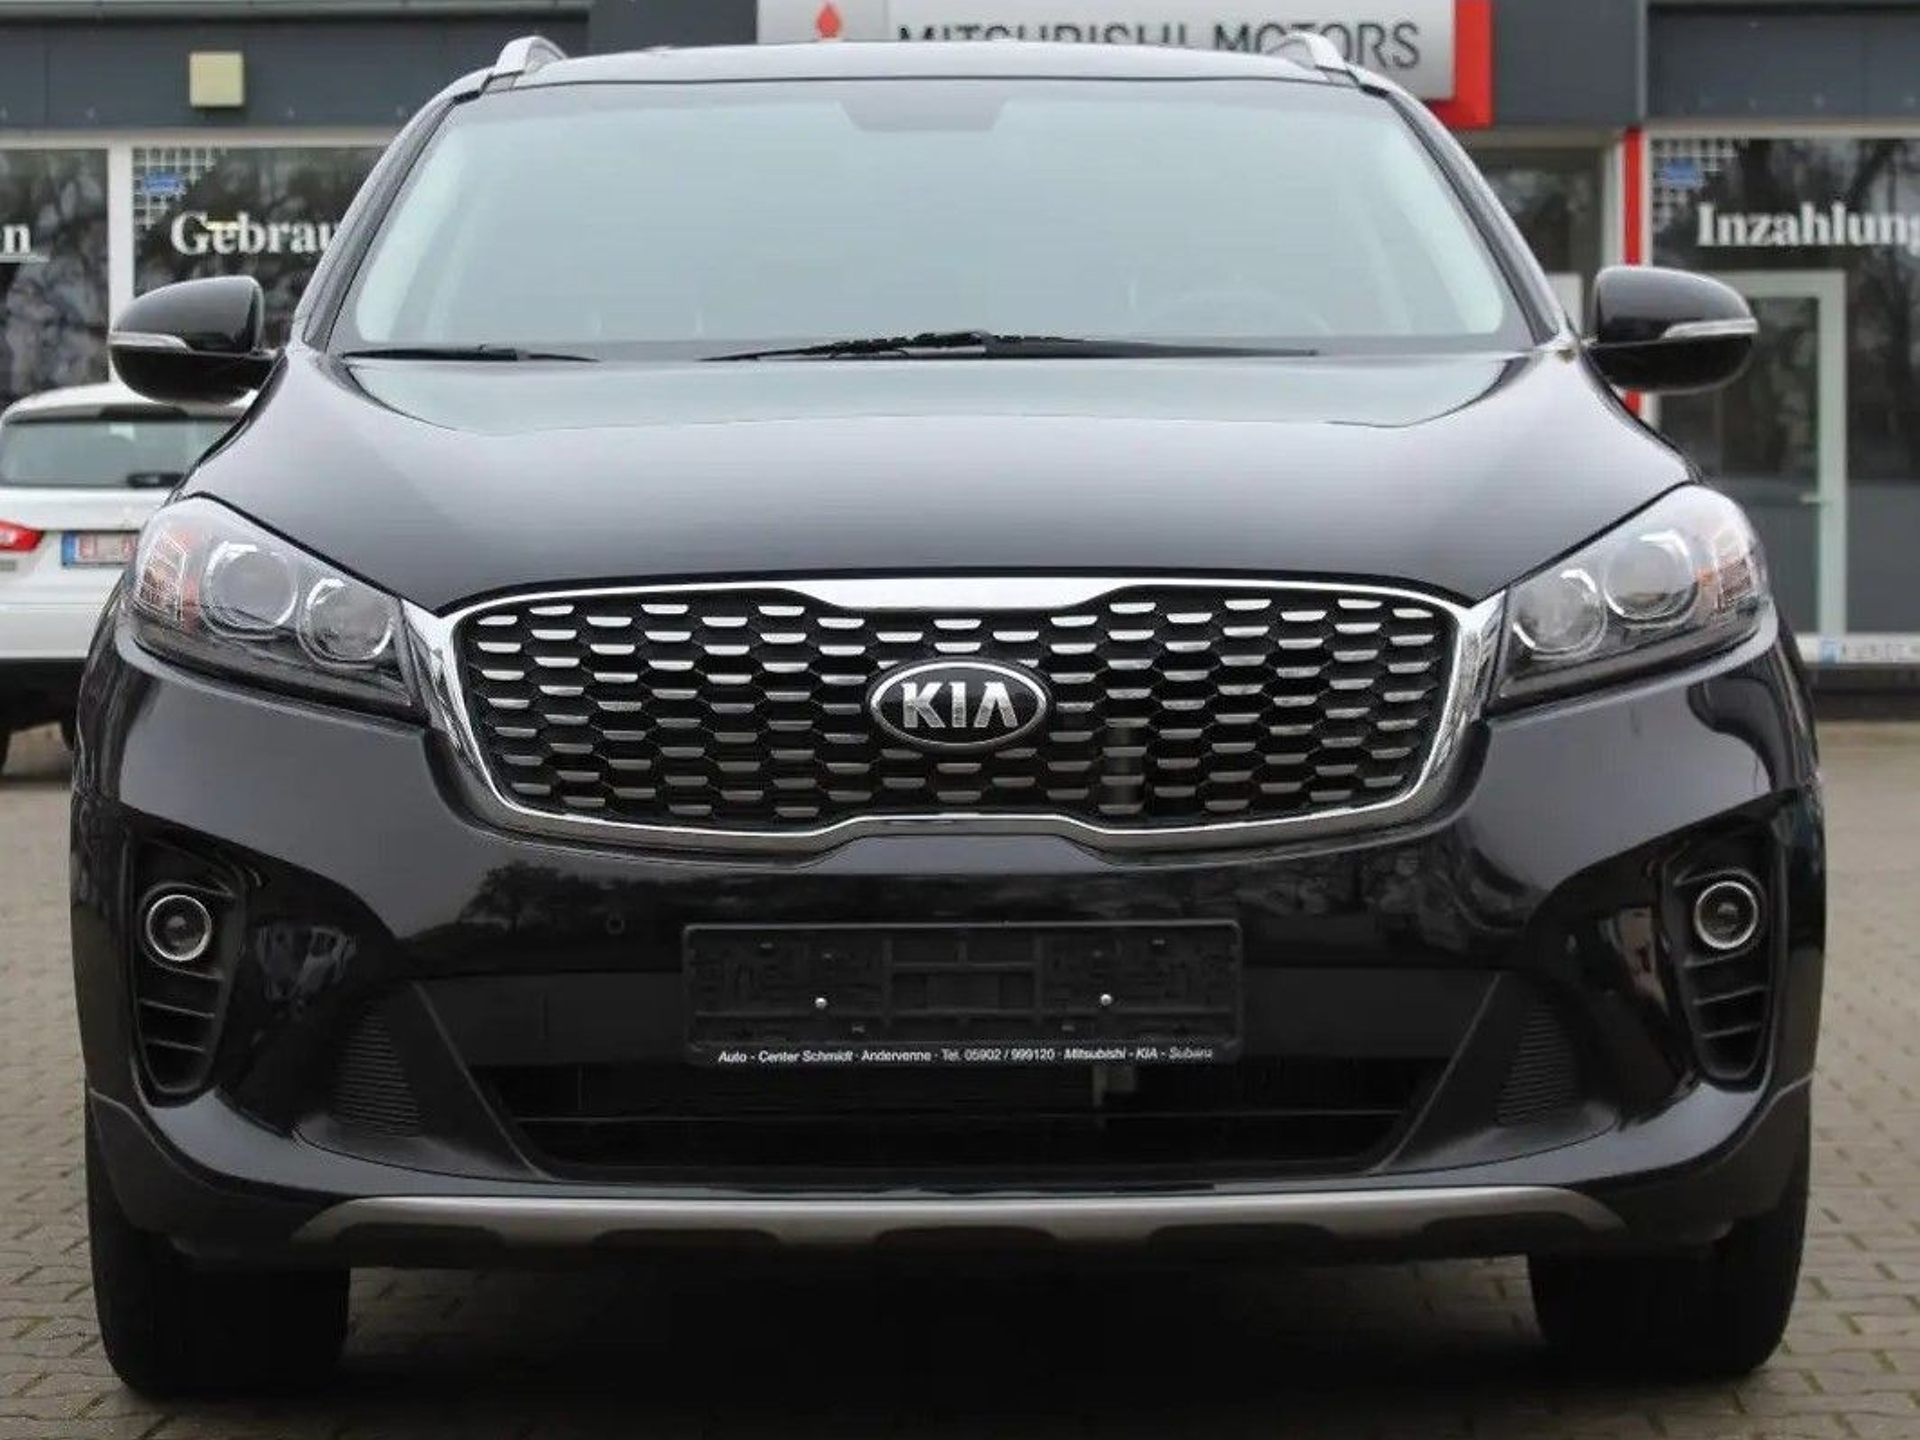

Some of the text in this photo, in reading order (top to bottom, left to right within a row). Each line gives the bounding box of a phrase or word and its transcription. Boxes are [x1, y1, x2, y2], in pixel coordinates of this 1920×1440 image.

[1214, 23, 1419, 68] MOORS
[902, 681, 1018, 728] KIA
[718, 1051, 747, 1063] Auto
[758, 1050, 800, 1063] Center
[802, 1050, 853, 1062] Schmidt
[861, 1050, 932, 1062] Andervenne
[964, 1048, 1001, 1061] 05902
[1064, 1047, 1126, 1060] Mitsubishi
[1136, 1047, 1158, 1060] KIA
